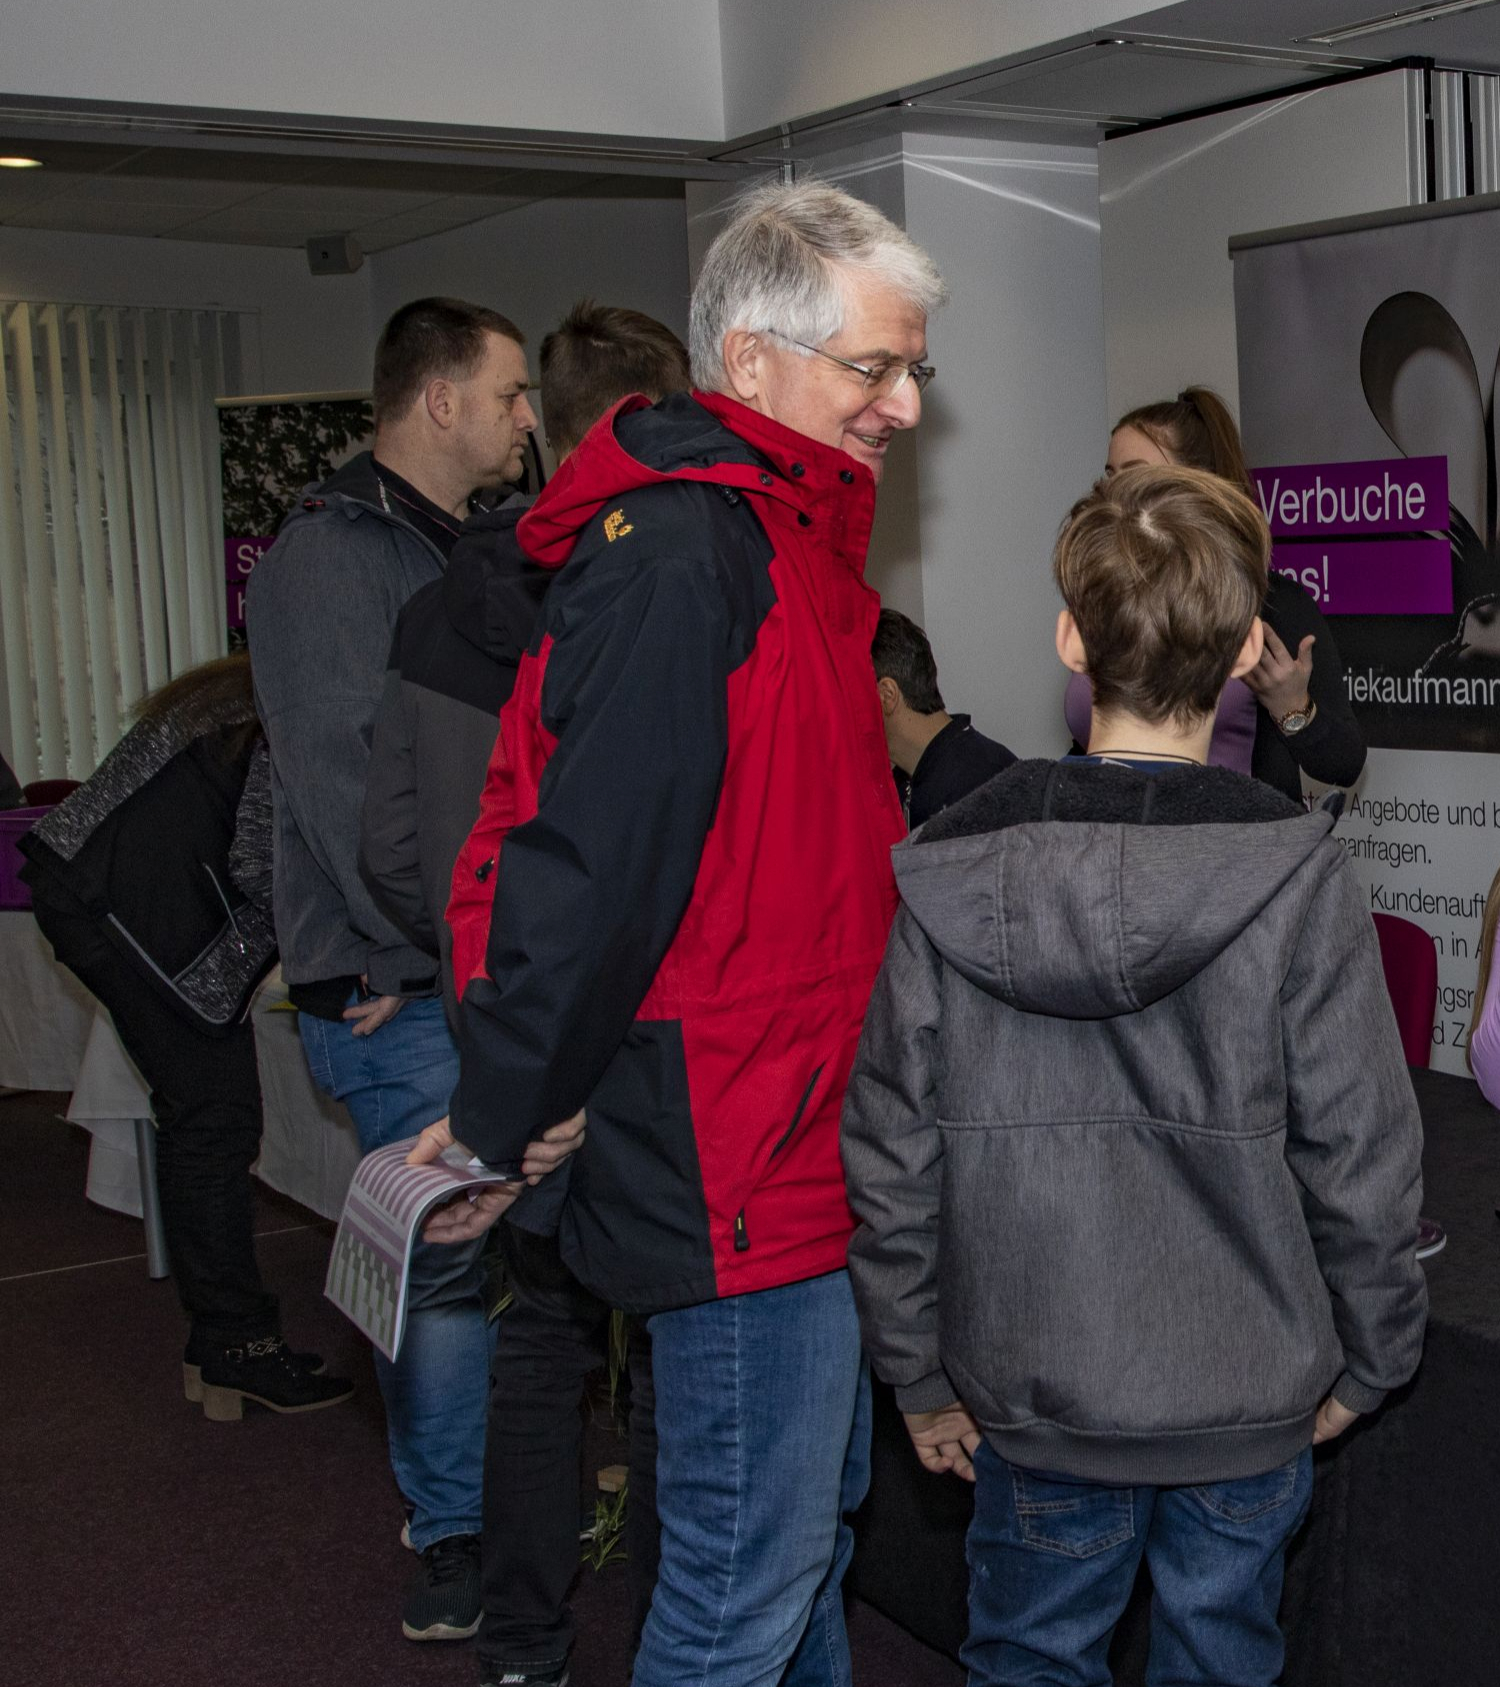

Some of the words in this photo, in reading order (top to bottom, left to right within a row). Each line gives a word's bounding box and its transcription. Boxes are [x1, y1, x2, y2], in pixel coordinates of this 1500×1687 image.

[1257, 472, 1426, 526] Verbuche
[1349, 792, 1440, 828] Angebote
[1447, 801, 1486, 828] und
